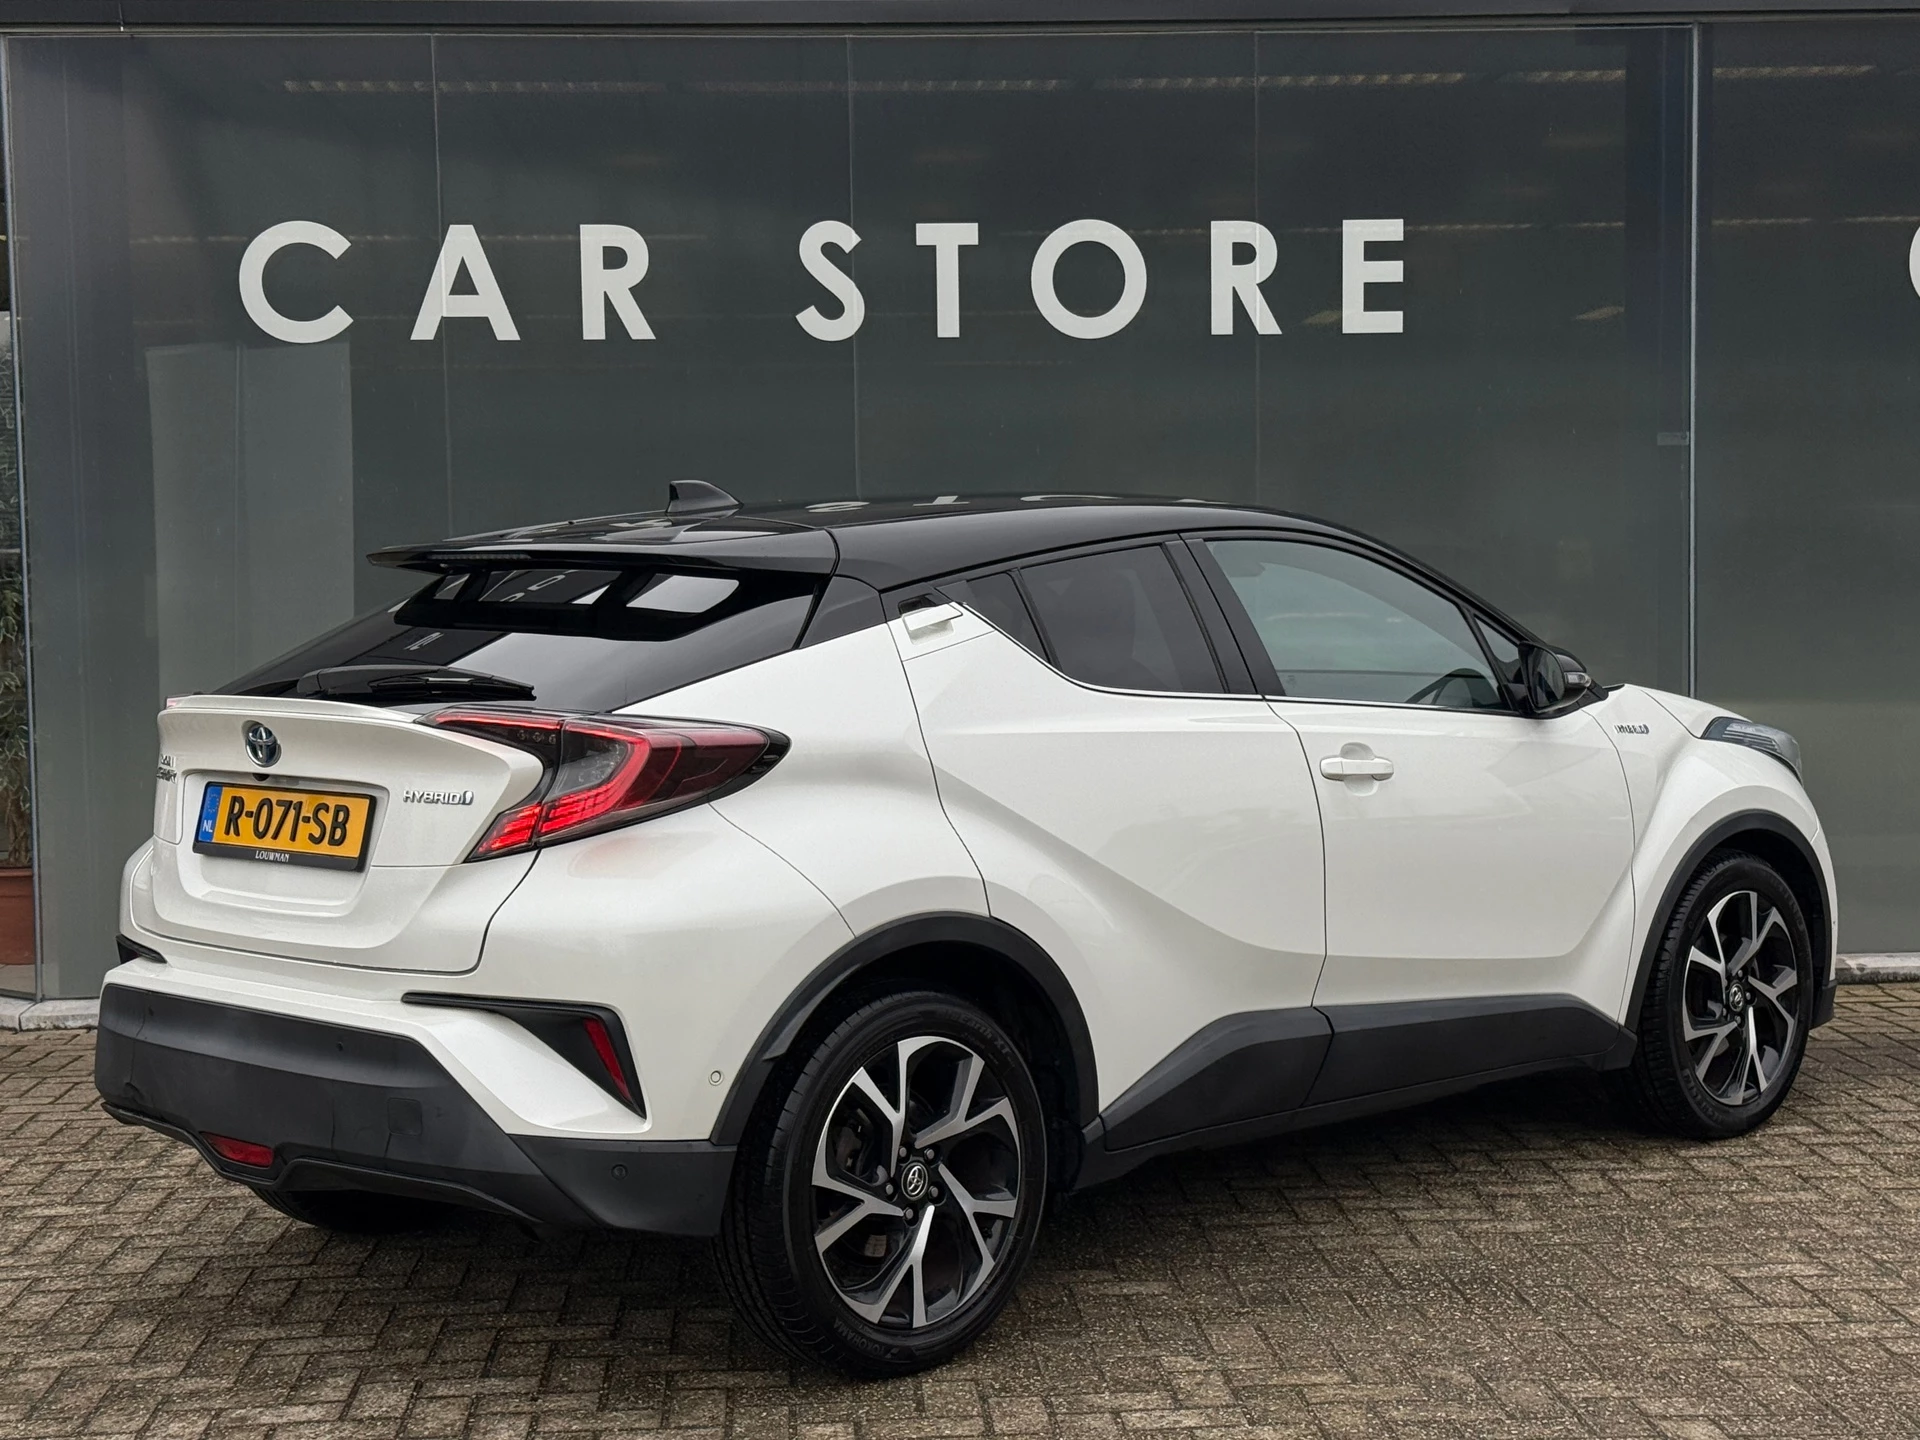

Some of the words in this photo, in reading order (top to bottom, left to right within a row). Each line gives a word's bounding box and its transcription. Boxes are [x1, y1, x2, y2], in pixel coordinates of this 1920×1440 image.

[239, 220, 656, 344] CAR
[795, 218, 1404, 341] STORE
[403, 790, 460, 806] HYBRID
[202, 819, 214, 833] NL
[223, 795, 350, 847] R-071-SB
[255, 850, 290, 863] LOUWMAN
